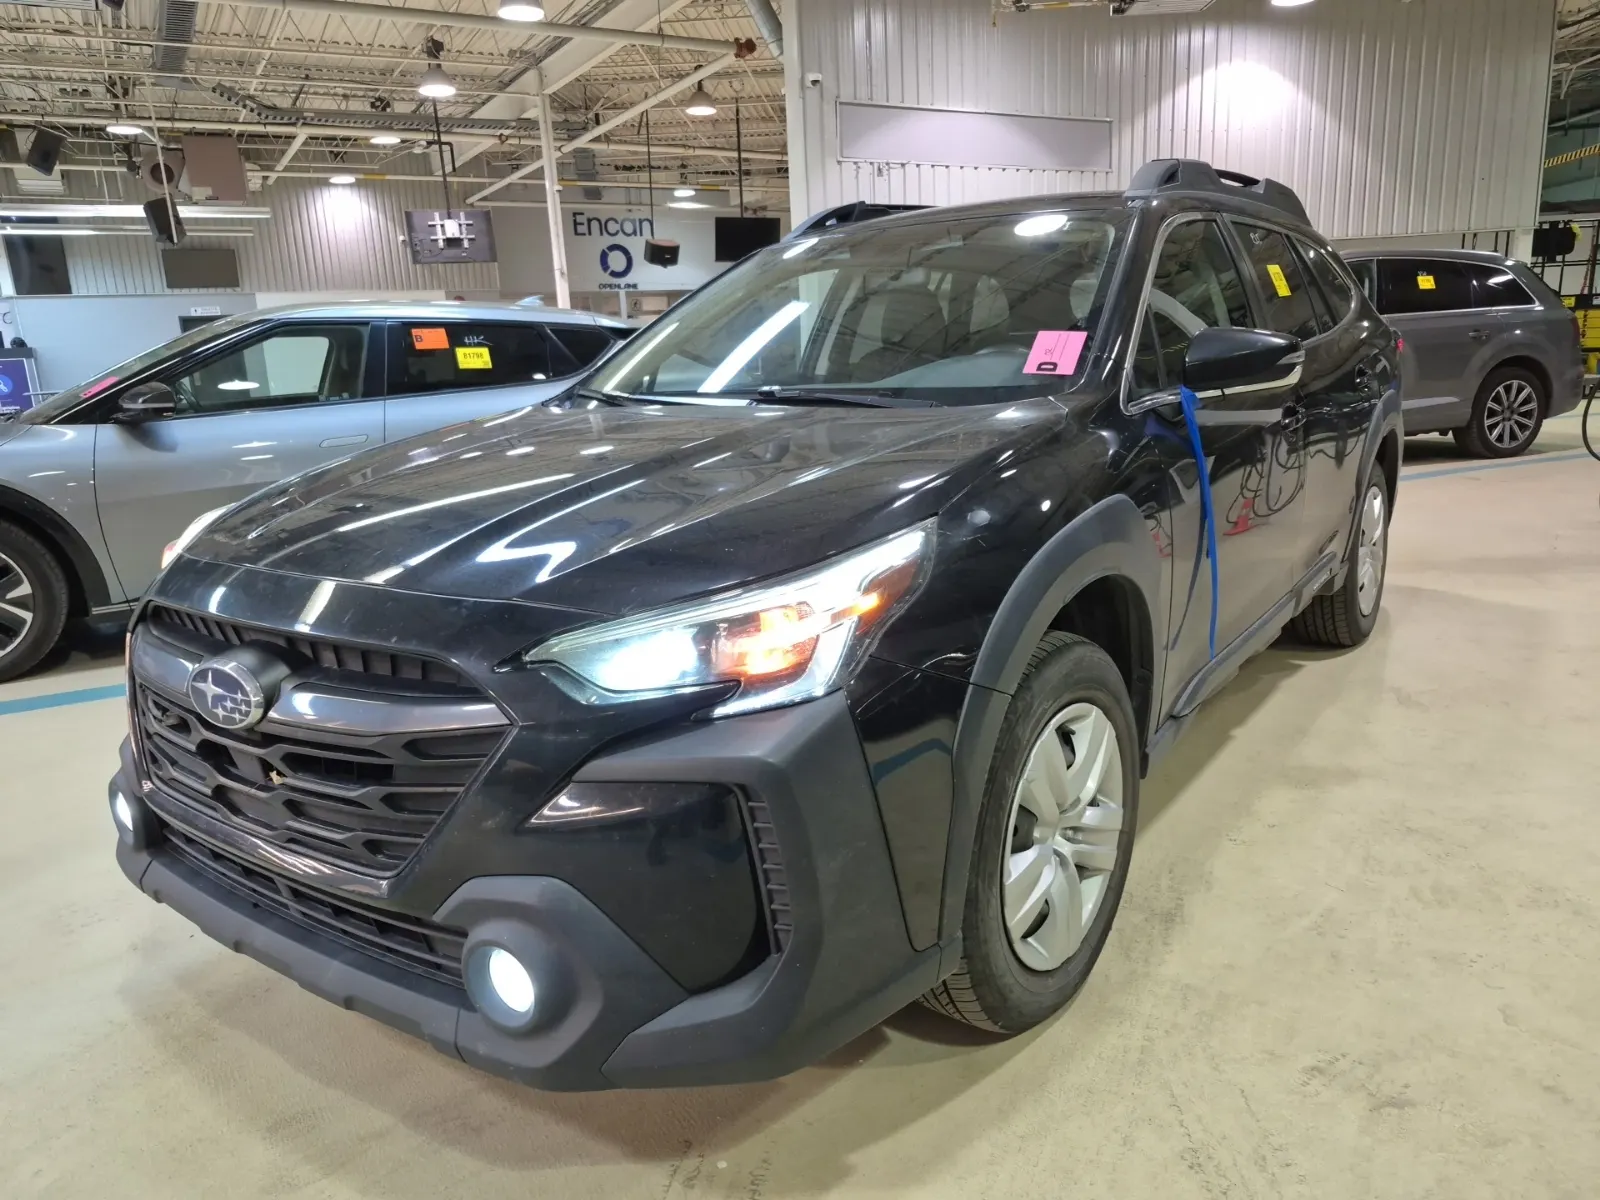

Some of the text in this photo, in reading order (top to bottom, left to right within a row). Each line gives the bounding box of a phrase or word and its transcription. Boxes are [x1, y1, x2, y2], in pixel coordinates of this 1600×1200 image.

[572, 212, 654, 237] Encan
[414, 335, 423, 343] B
[1036, 362, 1058, 372] D
